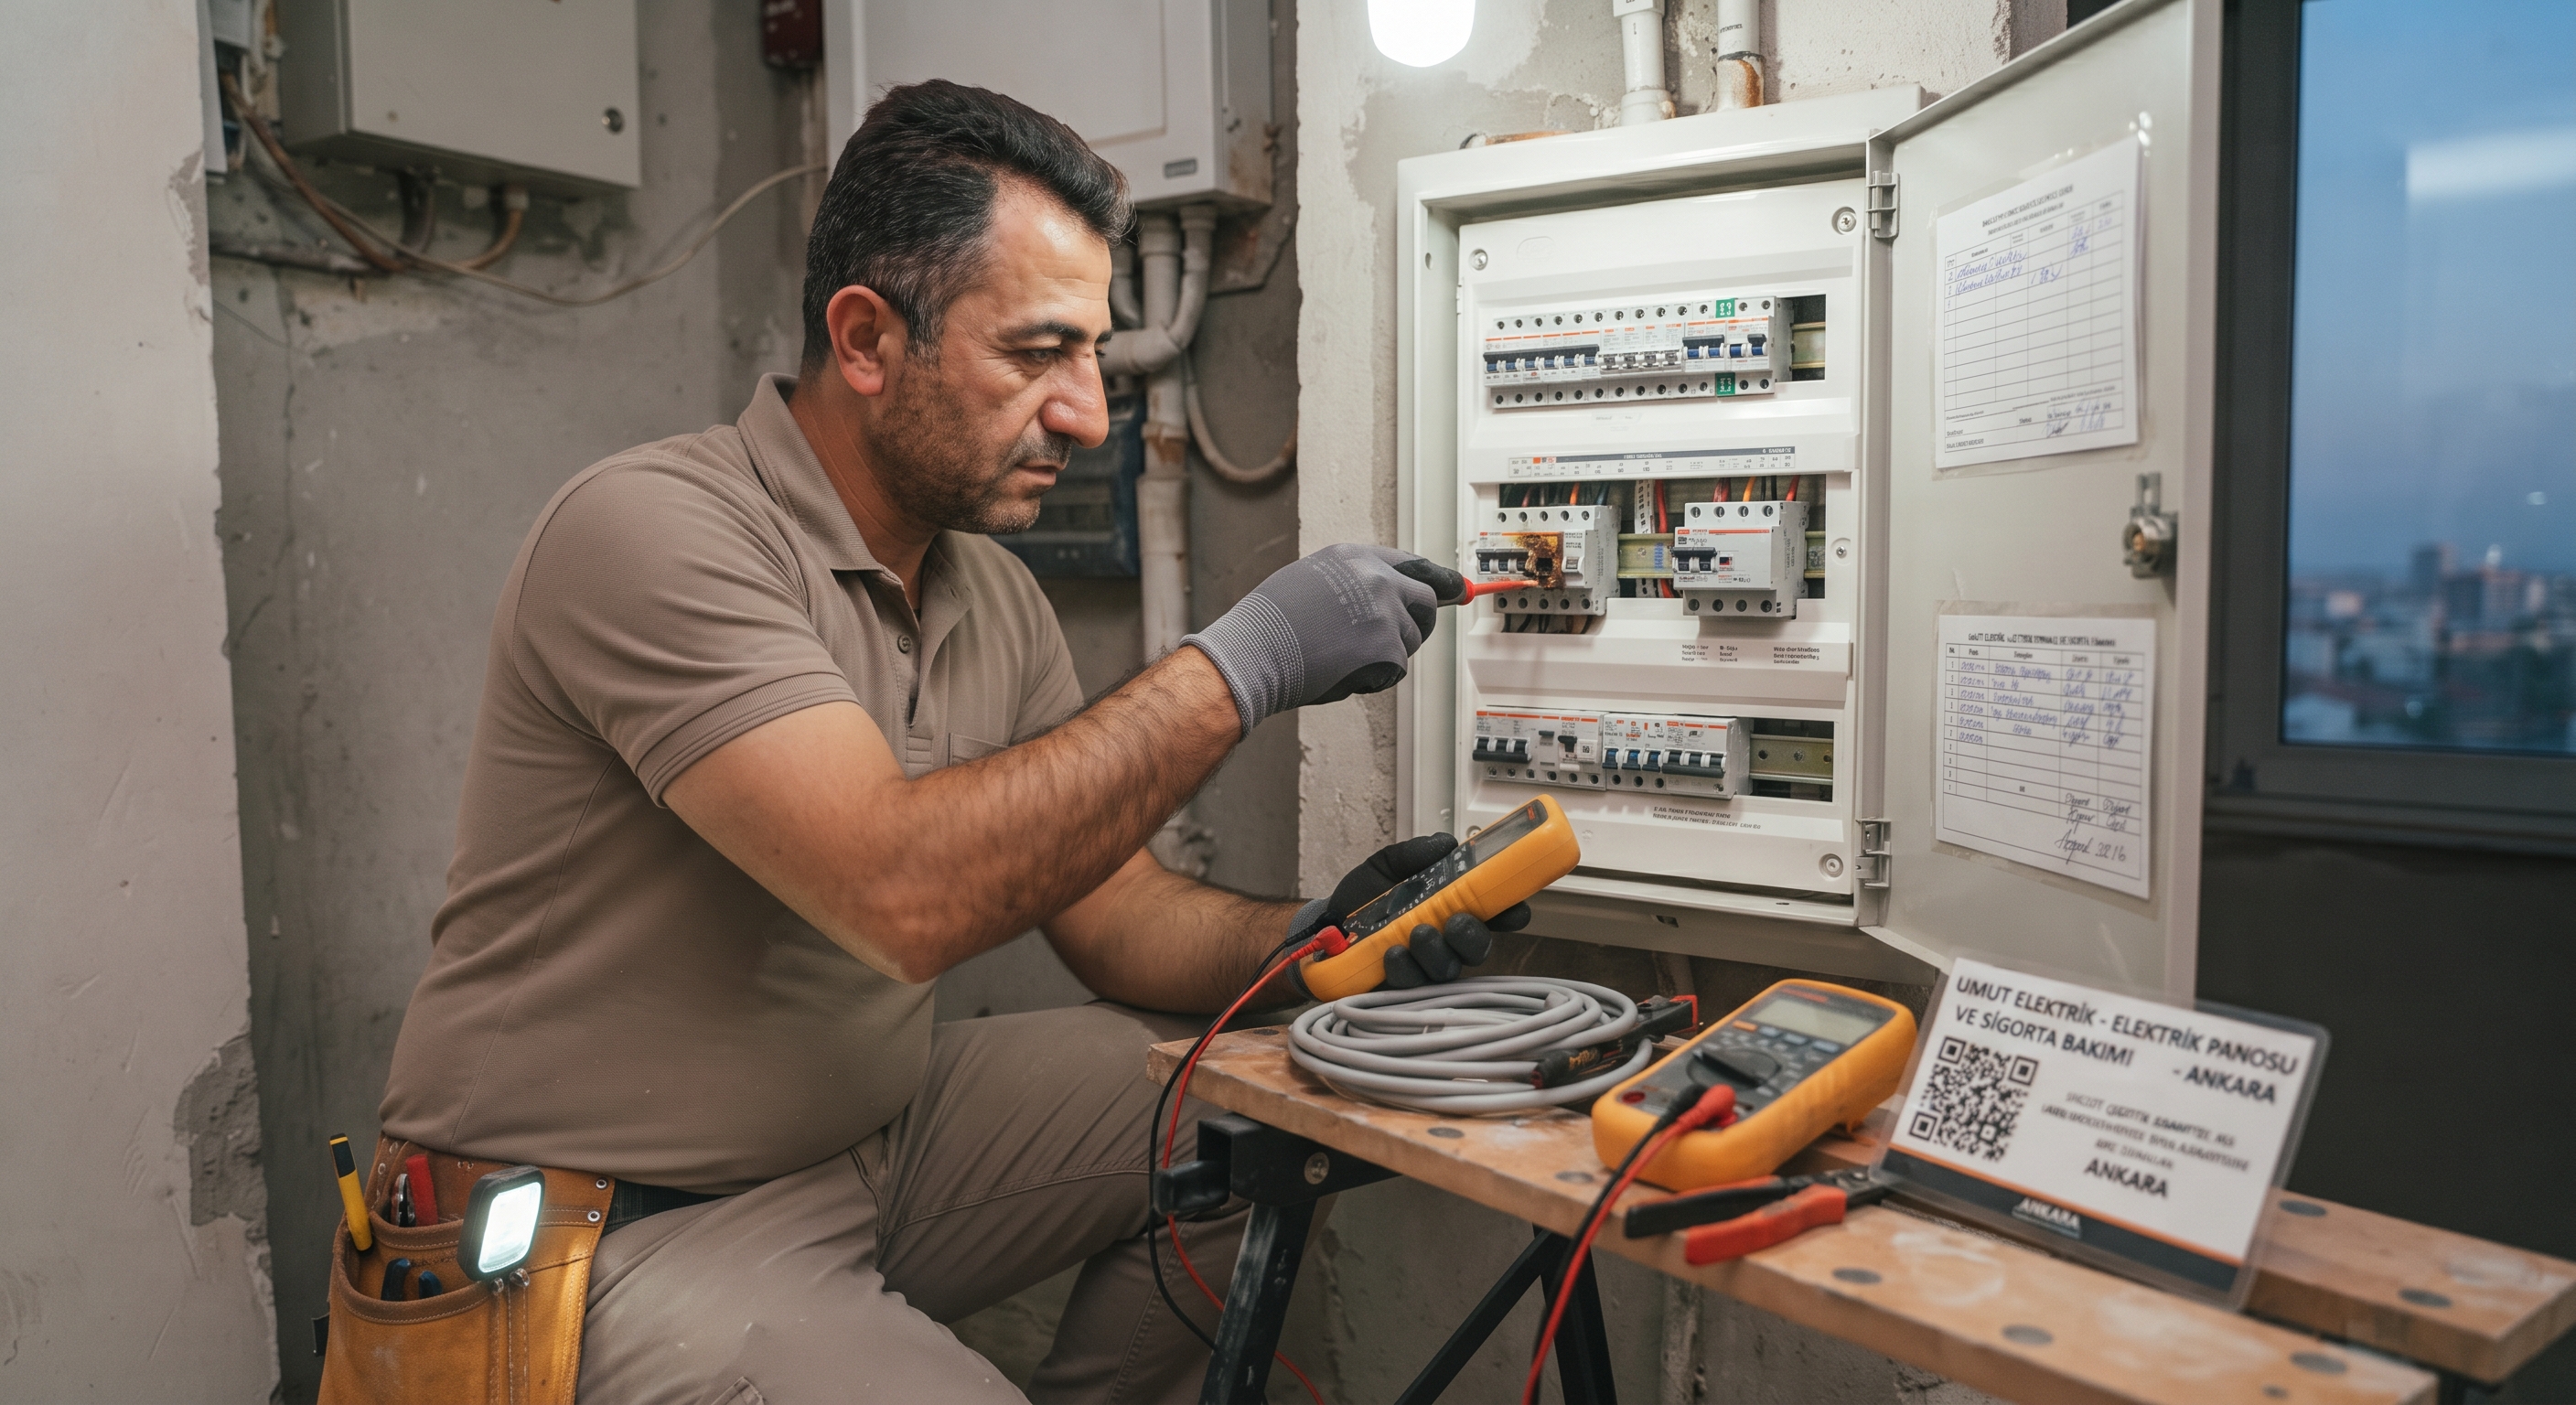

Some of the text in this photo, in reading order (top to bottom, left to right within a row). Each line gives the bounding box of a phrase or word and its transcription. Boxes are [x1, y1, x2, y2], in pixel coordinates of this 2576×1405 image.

[1956, 975, 2013, 1004] UMUT
[2013, 990, 2098, 1026] ELEKTRİK
[2110, 1014, 2204, 1053] ELEKTRİK
[2206, 1037, 2299, 1077] PANOSU
[1956, 1004, 1979, 1025] VE
[1980, 1007, 2057, 1048] SİGORTA
[2061, 1033, 2135, 1067] BAKIMI
[2184, 1065, 2277, 1105] ANKARA
[2018, 1196, 2081, 1230] ANKARA
[2084, 1158, 2169, 1198] ANKARA
